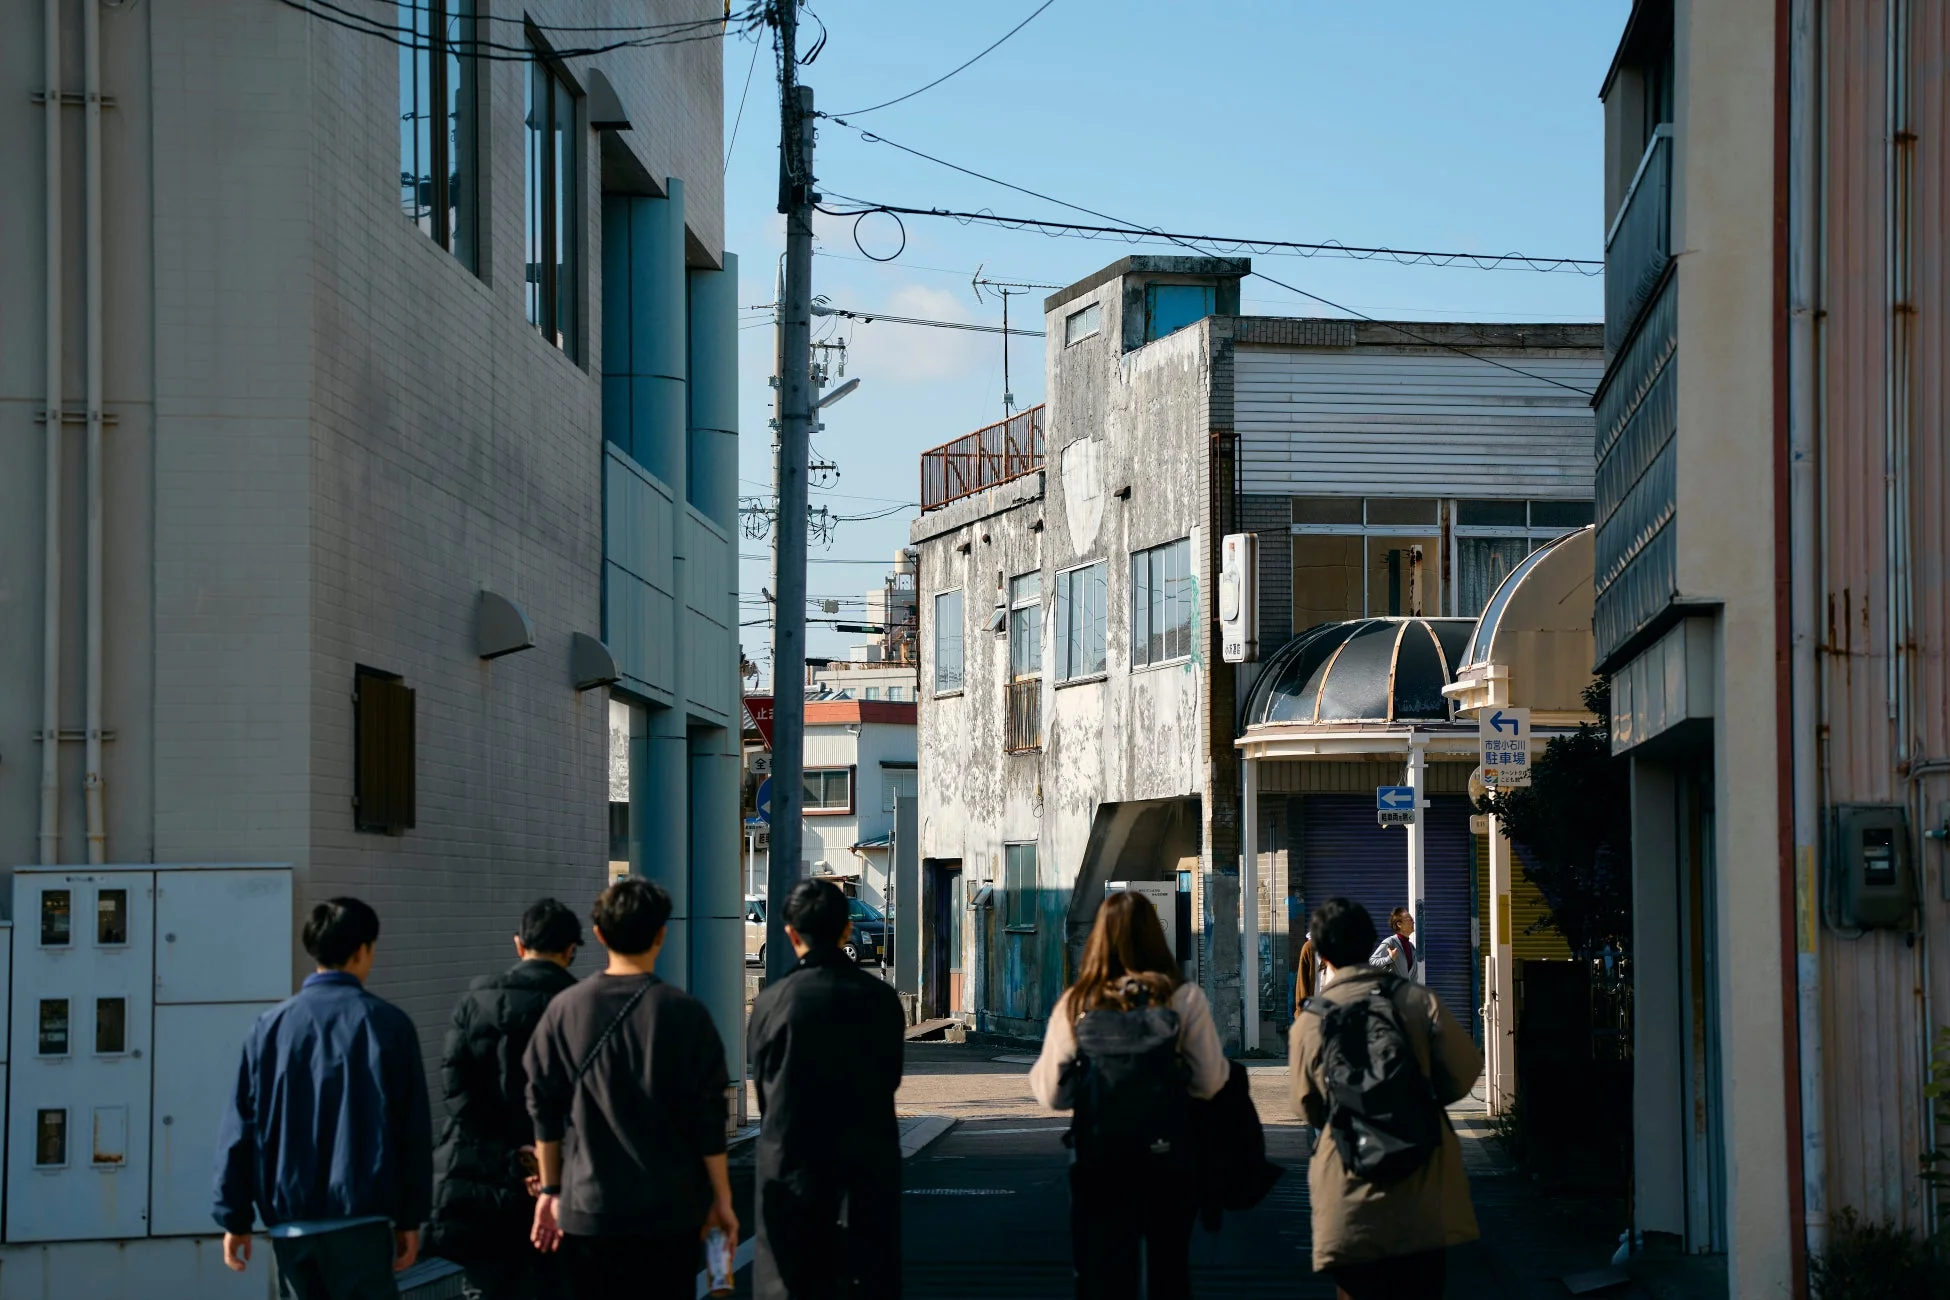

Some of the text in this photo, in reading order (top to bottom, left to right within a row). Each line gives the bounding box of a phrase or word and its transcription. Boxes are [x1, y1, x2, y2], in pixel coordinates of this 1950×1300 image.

[1485, 740, 1526, 750] 市営小石川
[755, 758, 772, 770] 全
[1485, 751, 1526, 765] 駐車場
